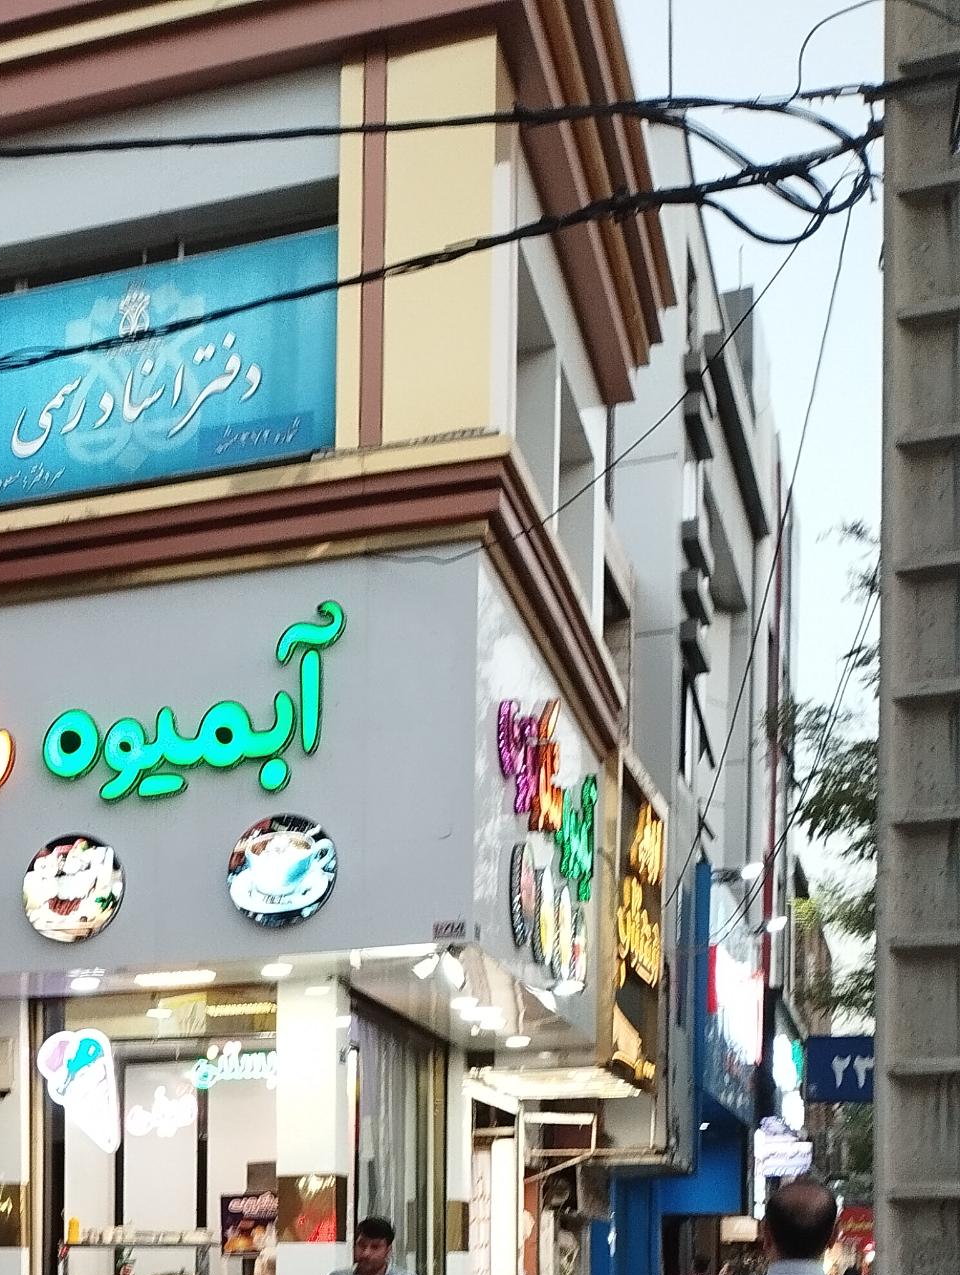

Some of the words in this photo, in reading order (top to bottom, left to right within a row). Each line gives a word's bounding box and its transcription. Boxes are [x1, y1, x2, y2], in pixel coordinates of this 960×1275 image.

[10, 374, 87, 459] رسمی
[94, 357, 185, 430] اسناد
[168, 332, 262, 438] دفتر
[42, 600, 344, 802] آبمیوه
